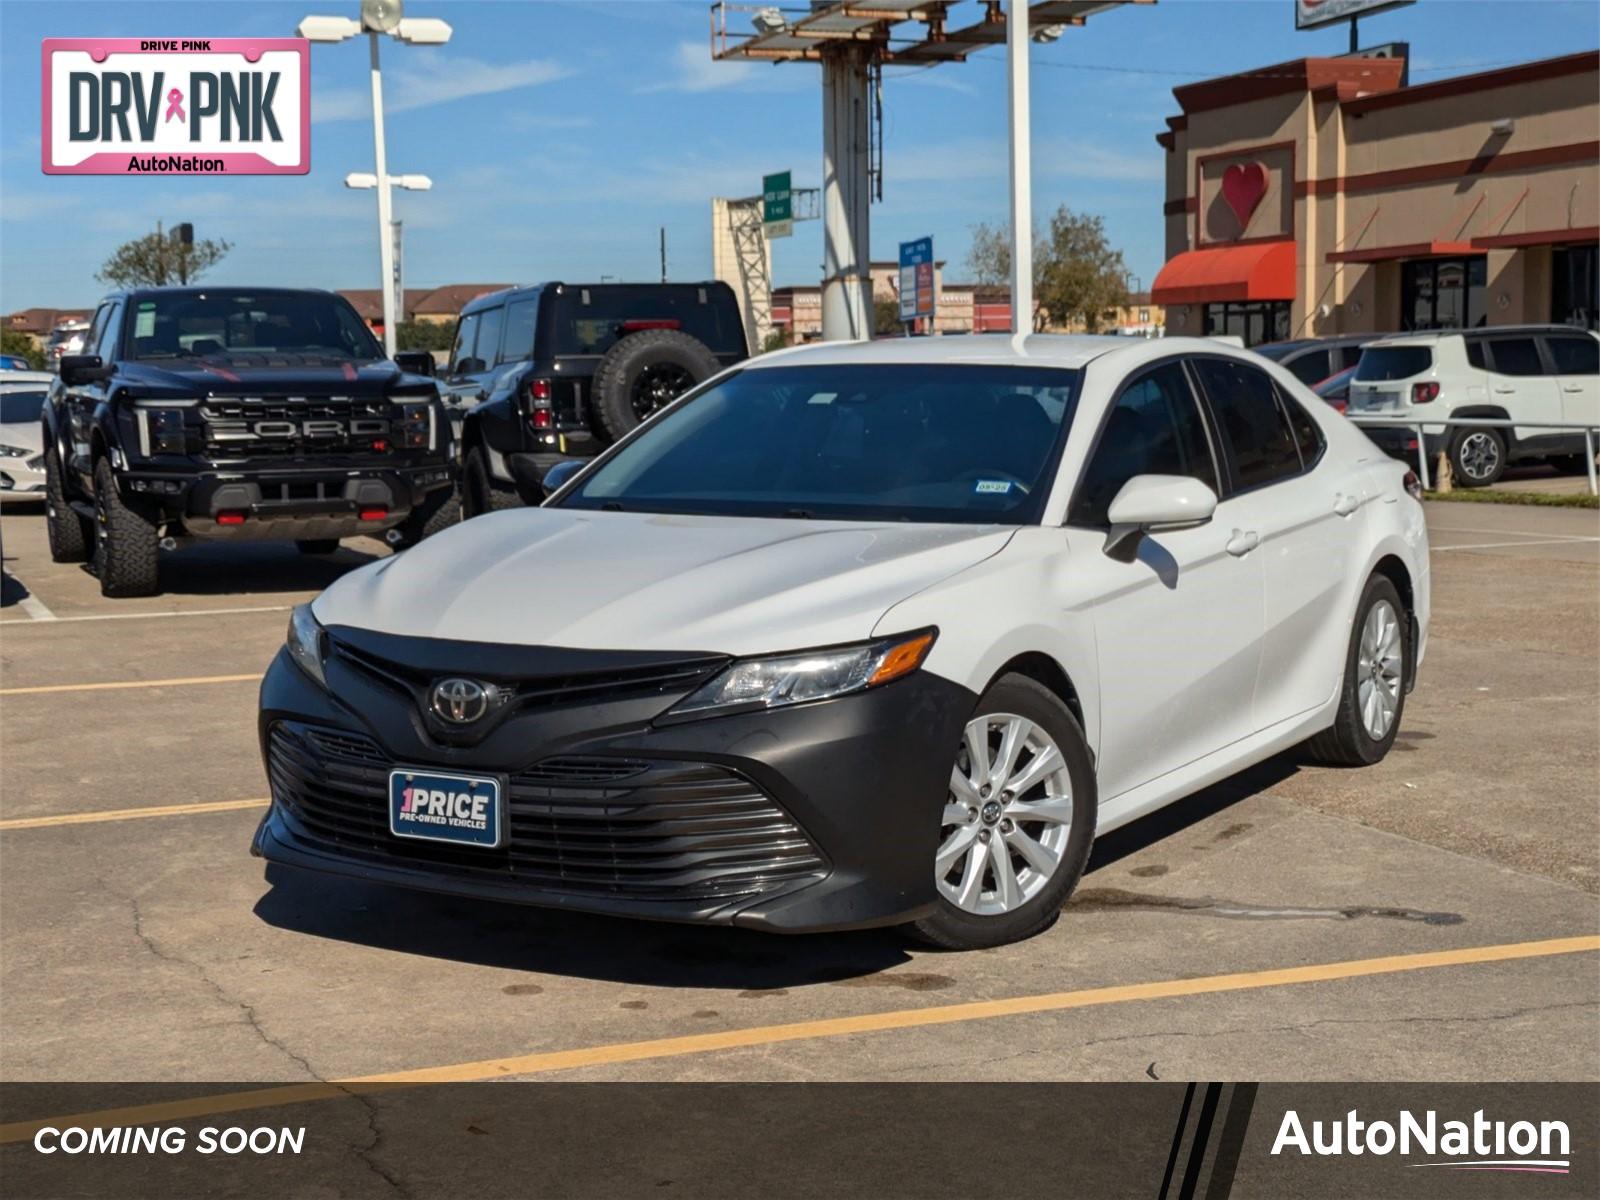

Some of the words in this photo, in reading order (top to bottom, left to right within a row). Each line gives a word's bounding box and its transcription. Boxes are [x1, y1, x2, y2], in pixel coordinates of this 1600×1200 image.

[400, 787, 489, 821] 1PRICE
[399, 812, 447, 825] PRE-OWNED
[448, 816, 487, 830] VEHICLES
